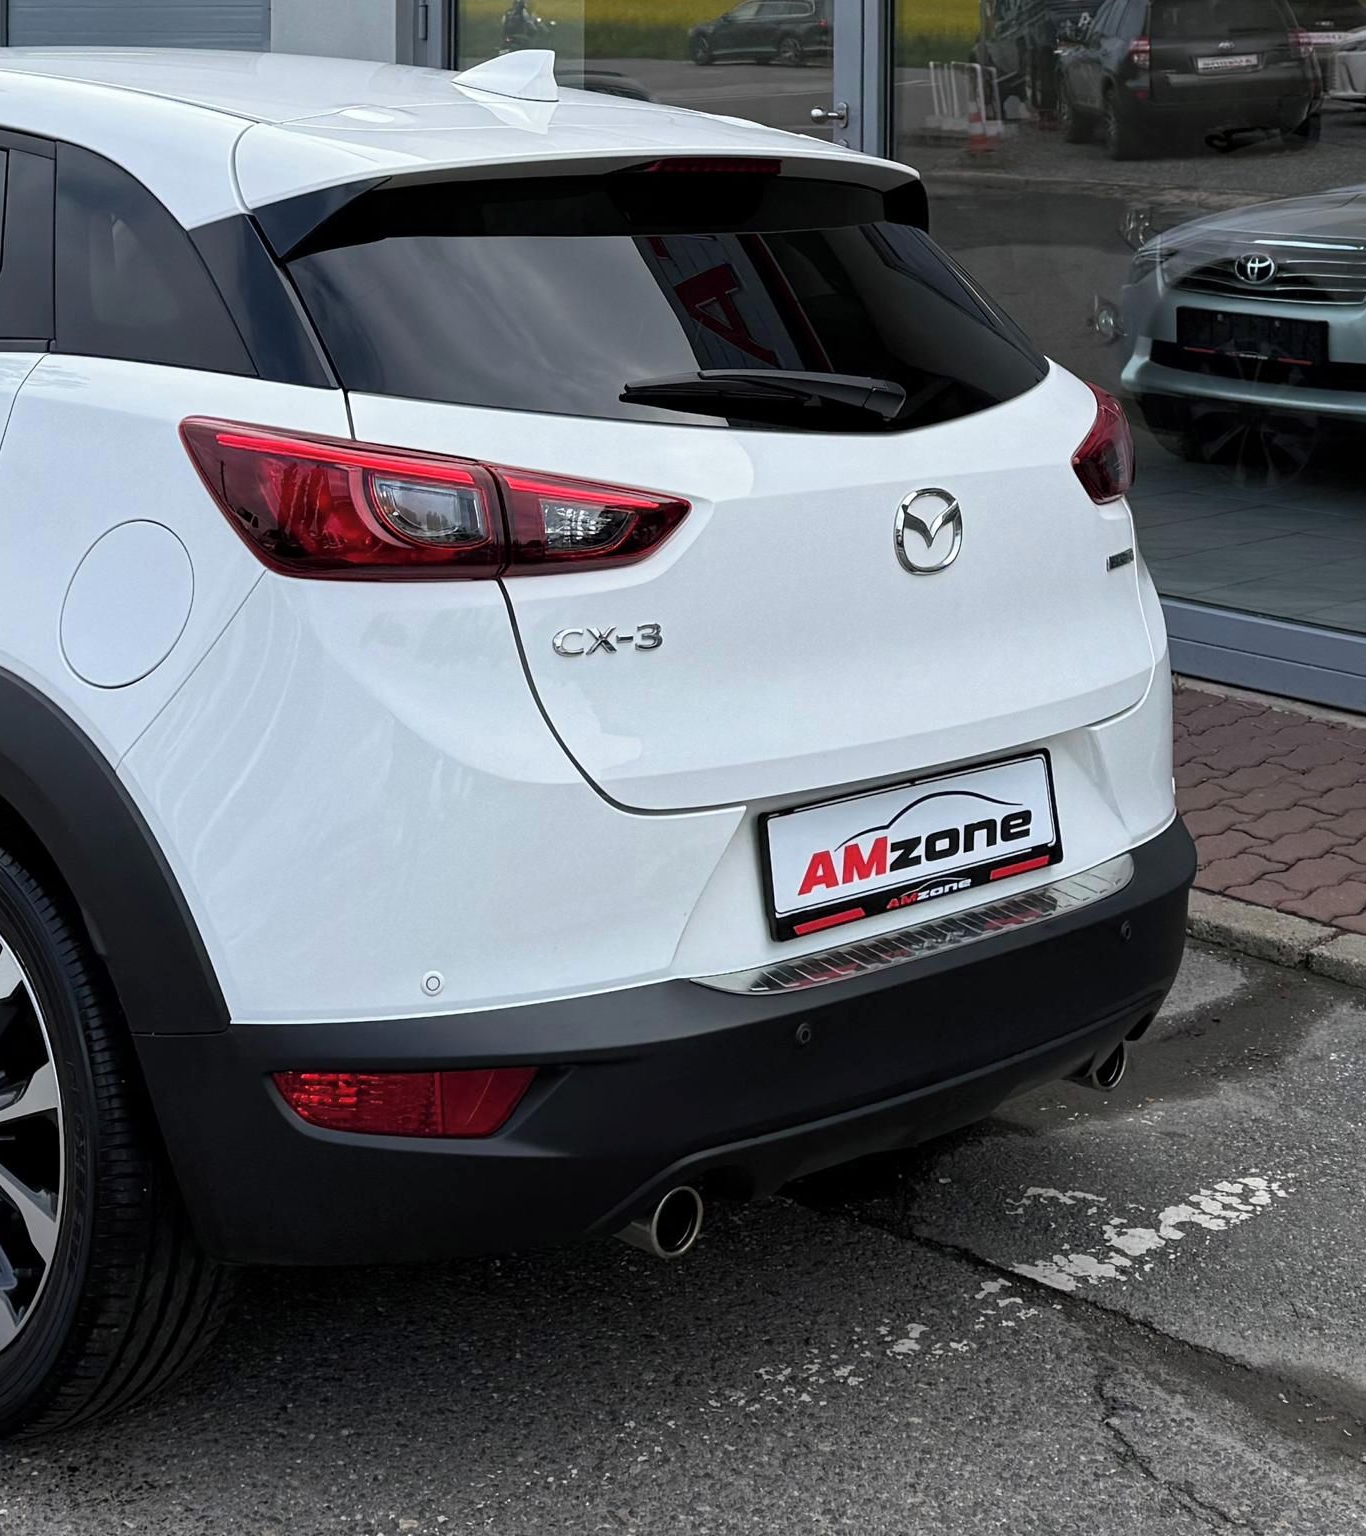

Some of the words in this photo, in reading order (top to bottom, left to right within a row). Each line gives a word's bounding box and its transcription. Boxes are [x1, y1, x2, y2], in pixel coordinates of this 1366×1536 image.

[551, 622, 663, 658] CX-3
[797, 809, 1033, 897] AMzone
[885, 877, 973, 910] AMzone
